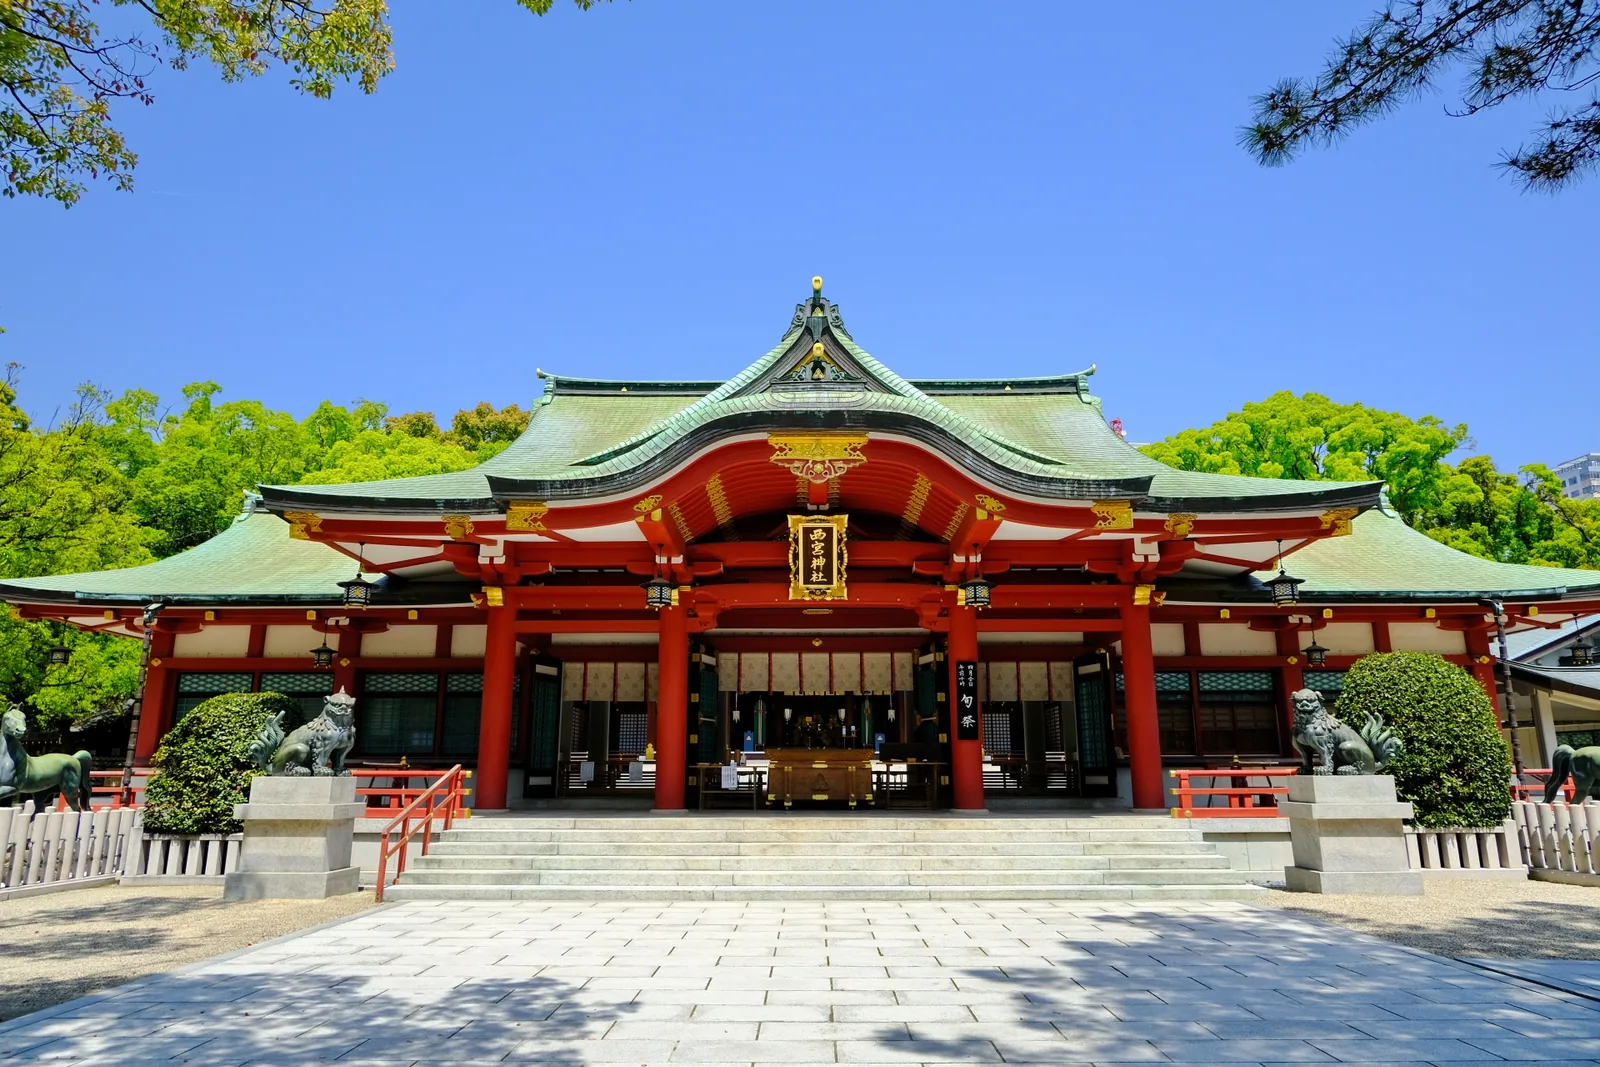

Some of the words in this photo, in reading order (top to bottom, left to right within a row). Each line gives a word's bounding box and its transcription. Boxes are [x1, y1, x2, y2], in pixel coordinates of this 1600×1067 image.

[809, 528, 827, 582] 西宮神社
[961, 694, 976, 728] 旬祭
